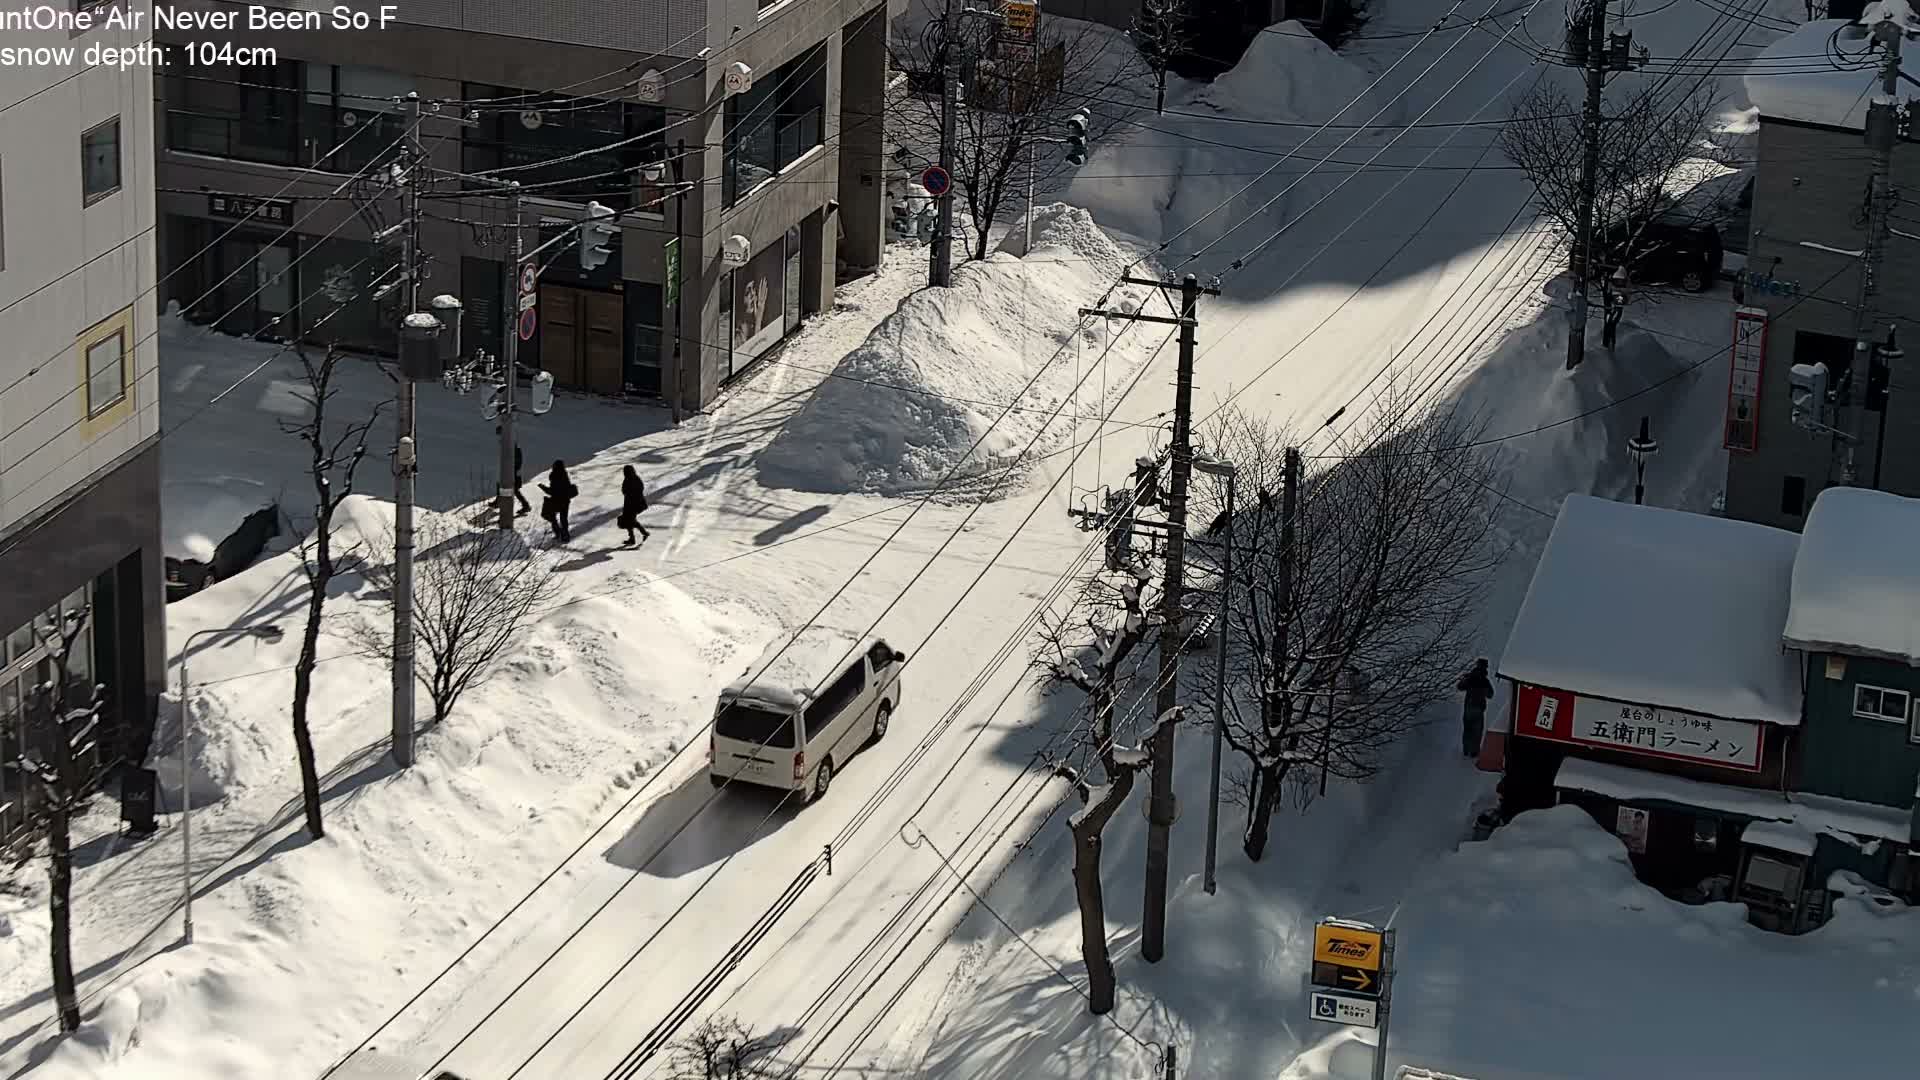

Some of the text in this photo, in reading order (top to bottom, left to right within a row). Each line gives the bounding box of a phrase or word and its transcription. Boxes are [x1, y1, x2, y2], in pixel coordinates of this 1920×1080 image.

[1539, 700, 1555, 728] 三角山
[1620, 706, 1714, 732] 屋台のしょうゆ味
[1590, 720, 1744, 758] 五衛門ラーメン
[1328, 938, 1371, 957] Times
